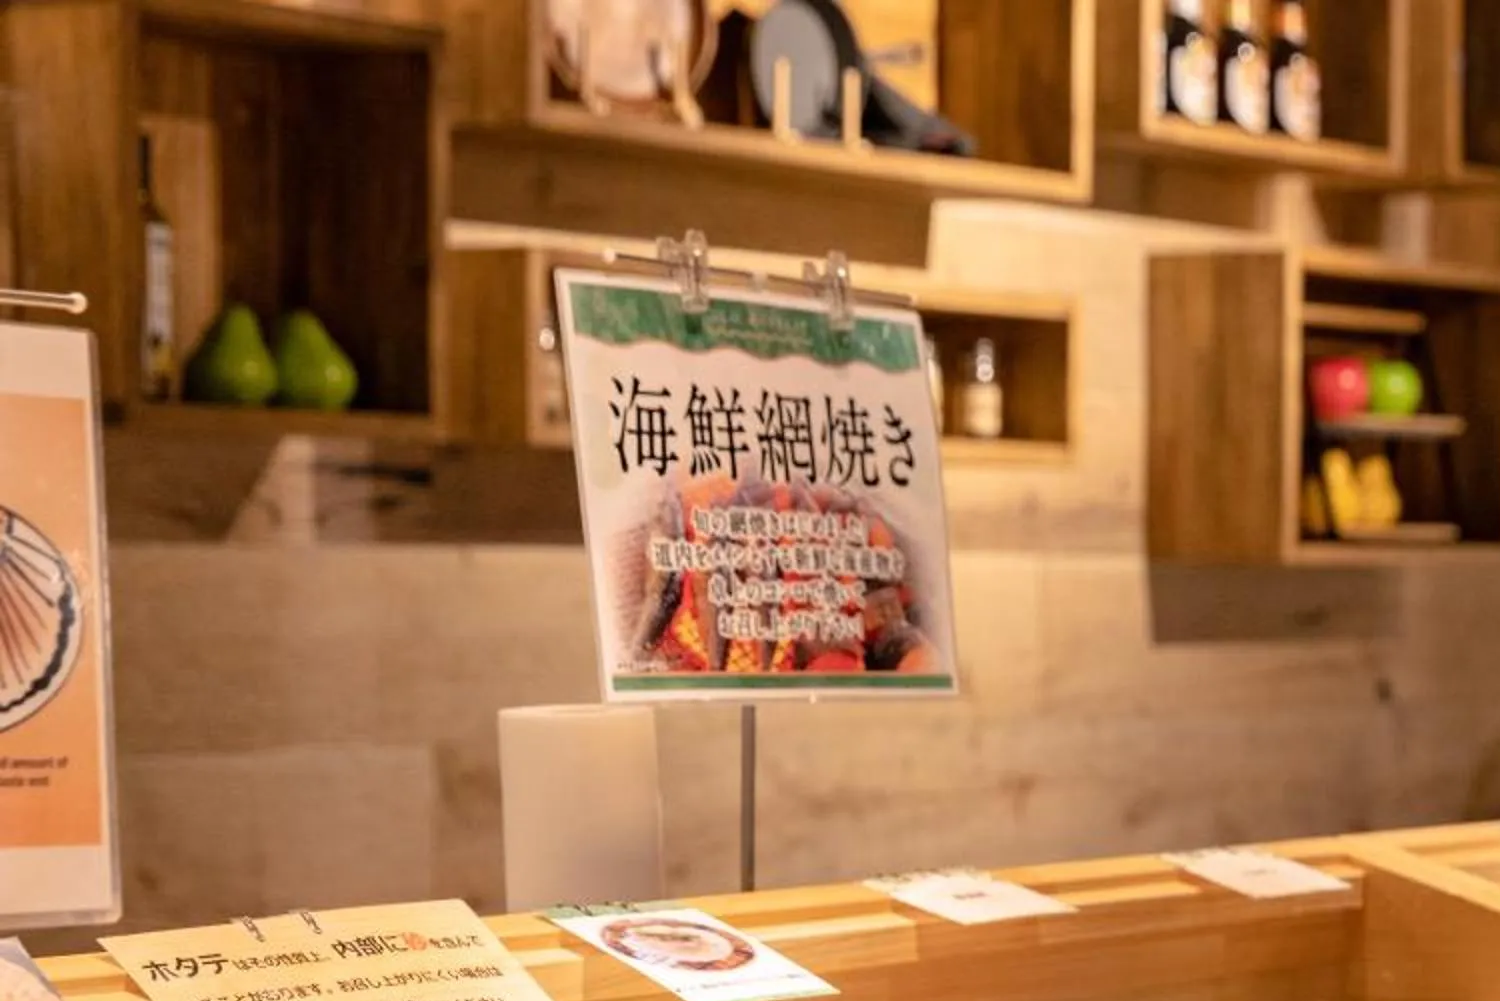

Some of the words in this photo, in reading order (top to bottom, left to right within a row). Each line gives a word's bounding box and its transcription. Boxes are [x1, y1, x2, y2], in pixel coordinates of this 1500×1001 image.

[608, 376, 917, 488] 海鮮網焼き
